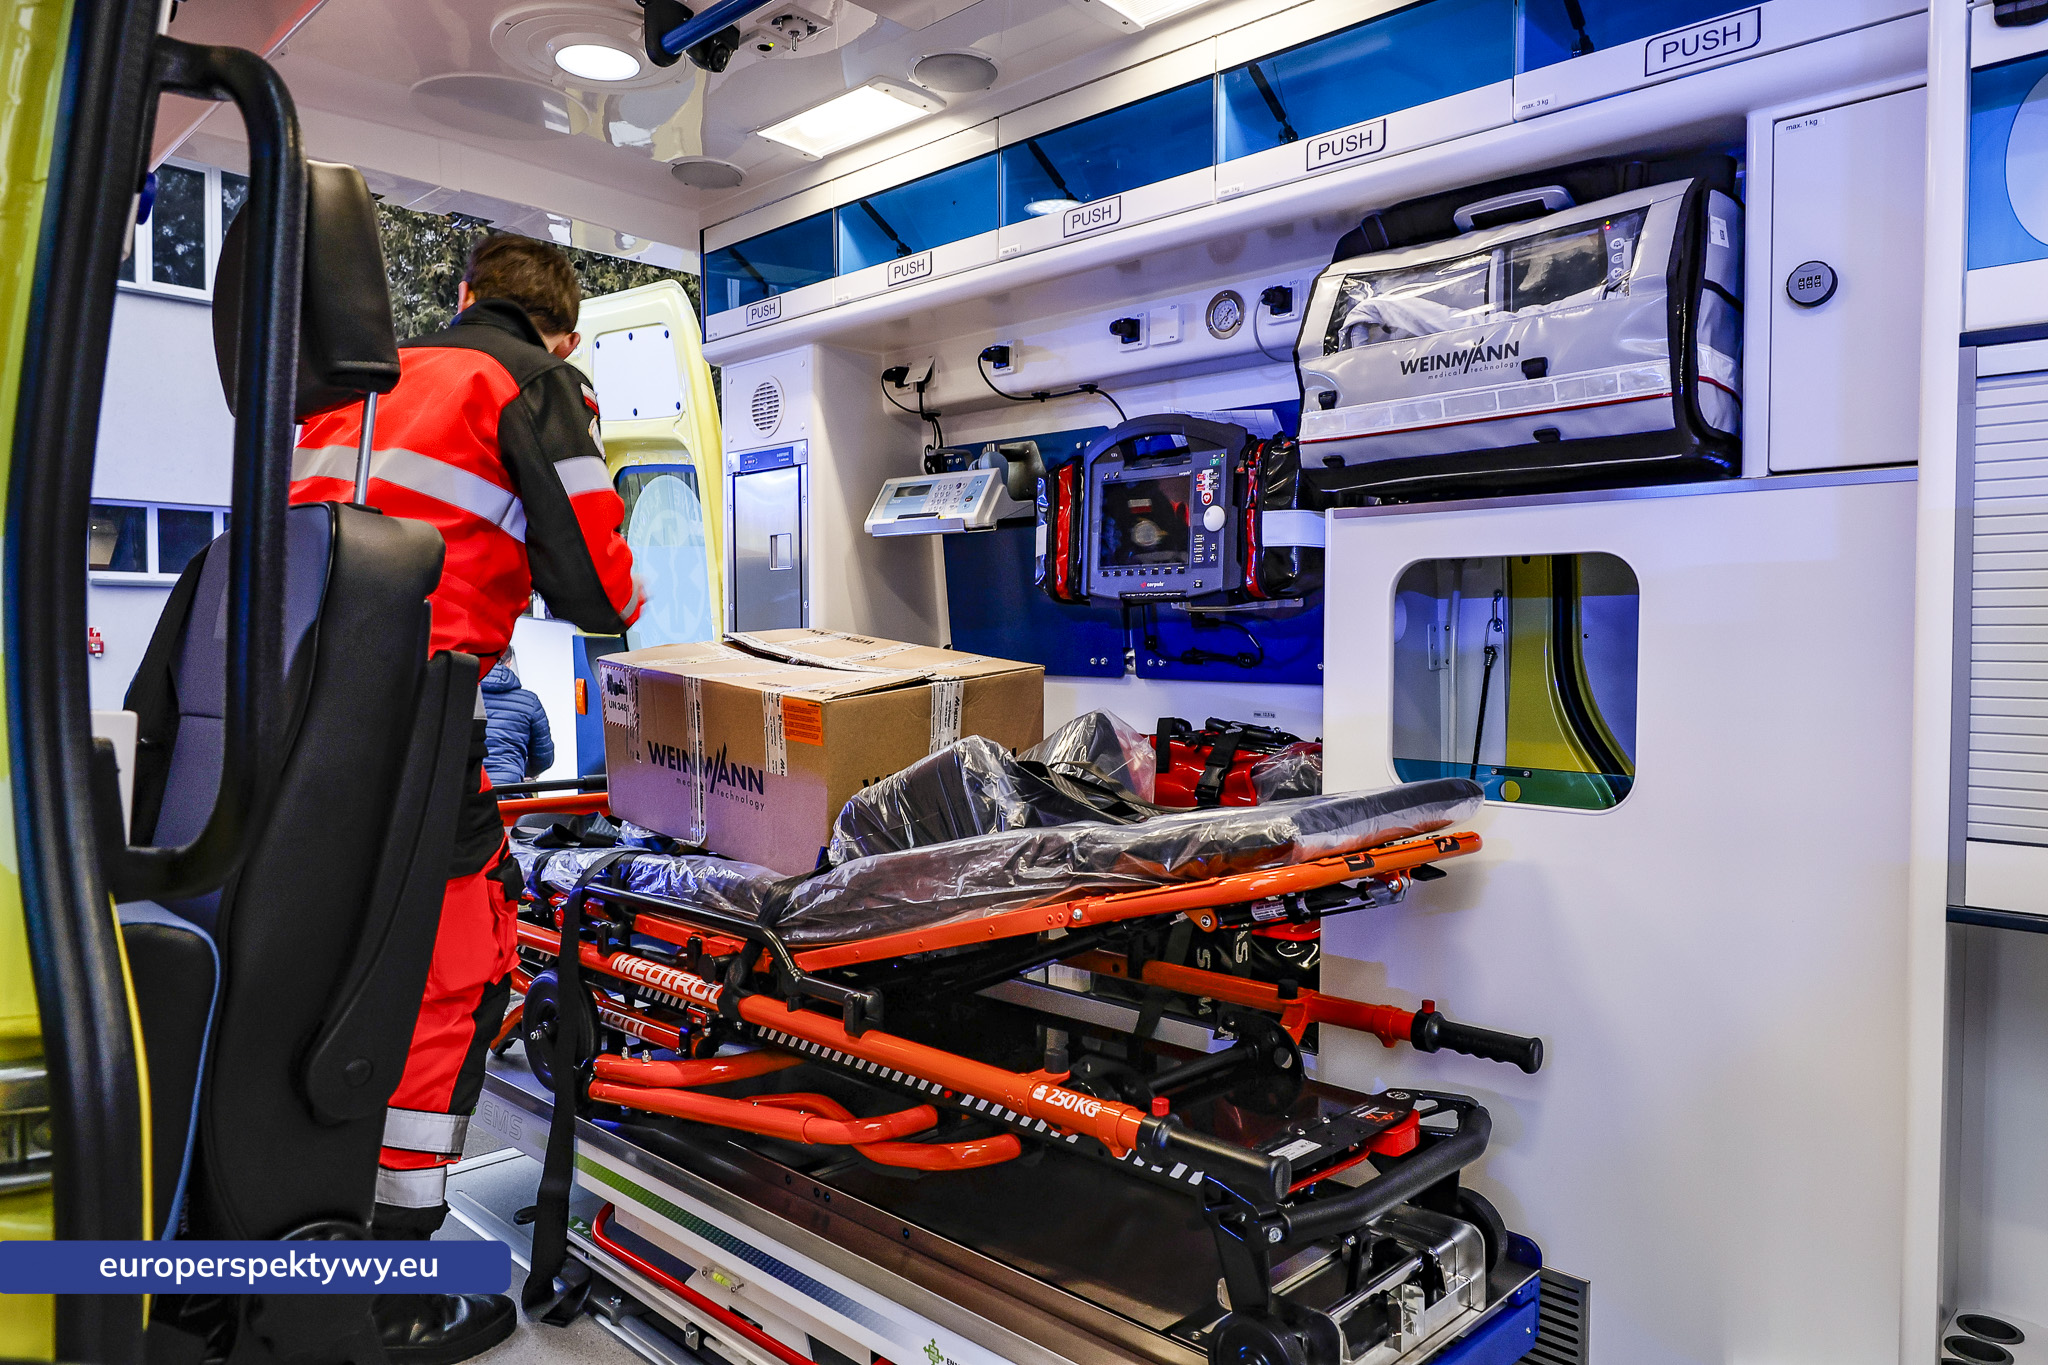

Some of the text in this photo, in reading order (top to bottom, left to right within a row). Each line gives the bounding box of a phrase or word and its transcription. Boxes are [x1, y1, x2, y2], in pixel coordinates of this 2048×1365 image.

[1662, 22, 1741, 63] PUSH
[1785, 123, 1802, 131] max.
[1318, 130, 1372, 161] PUSH
[1072, 204, 1112, 229] PUSH
[894, 258, 925, 279] PUSH
[751, 303, 776, 320] PUSH
[1400, 336, 1520, 376] WEINMANN
[1428, 361, 1520, 380] medical technology
[608, 700, 617, 709] UN
[647, 742, 764, 795] WEINMANN
[717, 788, 765, 811] technology
[481, 1100, 523, 1141] EMS
